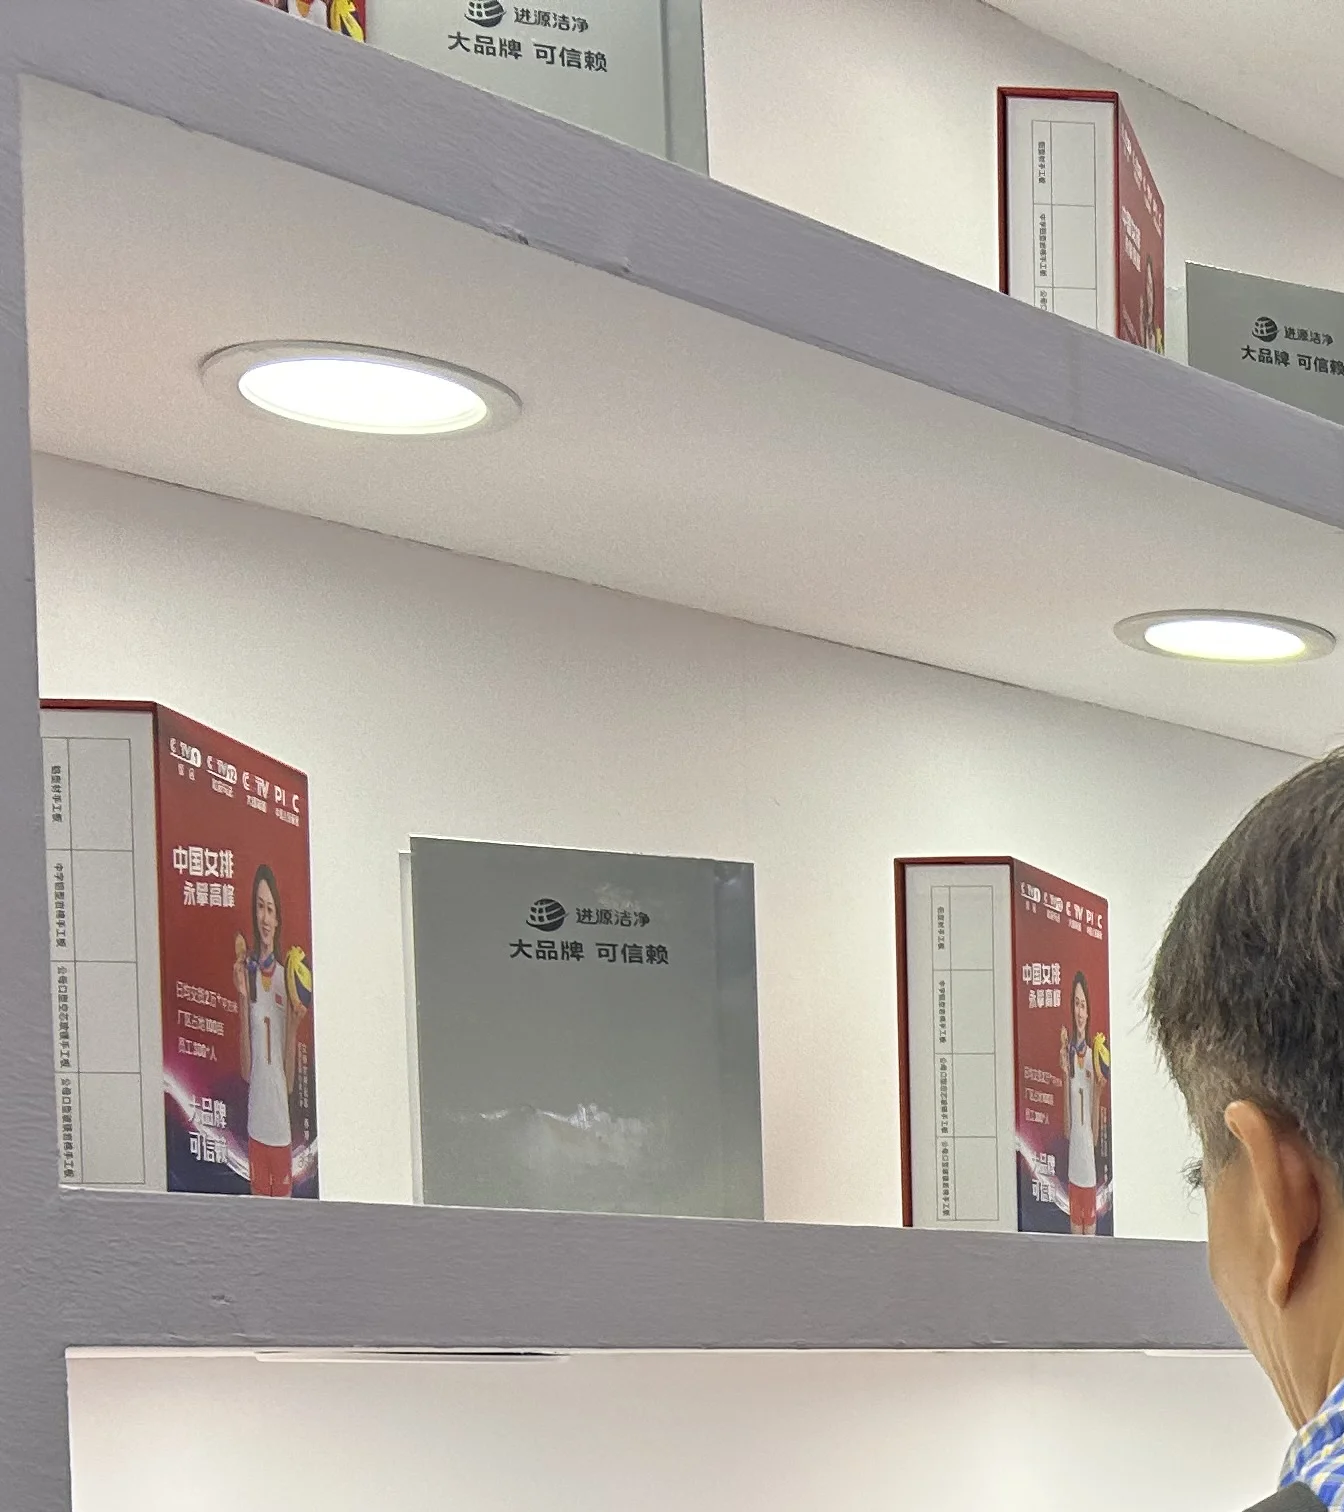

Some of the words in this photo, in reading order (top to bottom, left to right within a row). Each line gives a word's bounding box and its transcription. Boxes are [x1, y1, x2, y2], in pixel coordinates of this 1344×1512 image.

[513, 7, 589, 33] 进源洁净
[447, 31, 523, 60] 大品牌
[533, 42, 608, 73] 可信赖
[1241, 345, 1291, 368] 大品牌
[172, 845, 235, 879] 中国女排
[575, 906, 651, 928] 进源洁净
[509, 938, 585, 962] 大品牌
[595, 942, 670, 966] 可信赖
[187, 1094, 228, 1129] 大品牌
